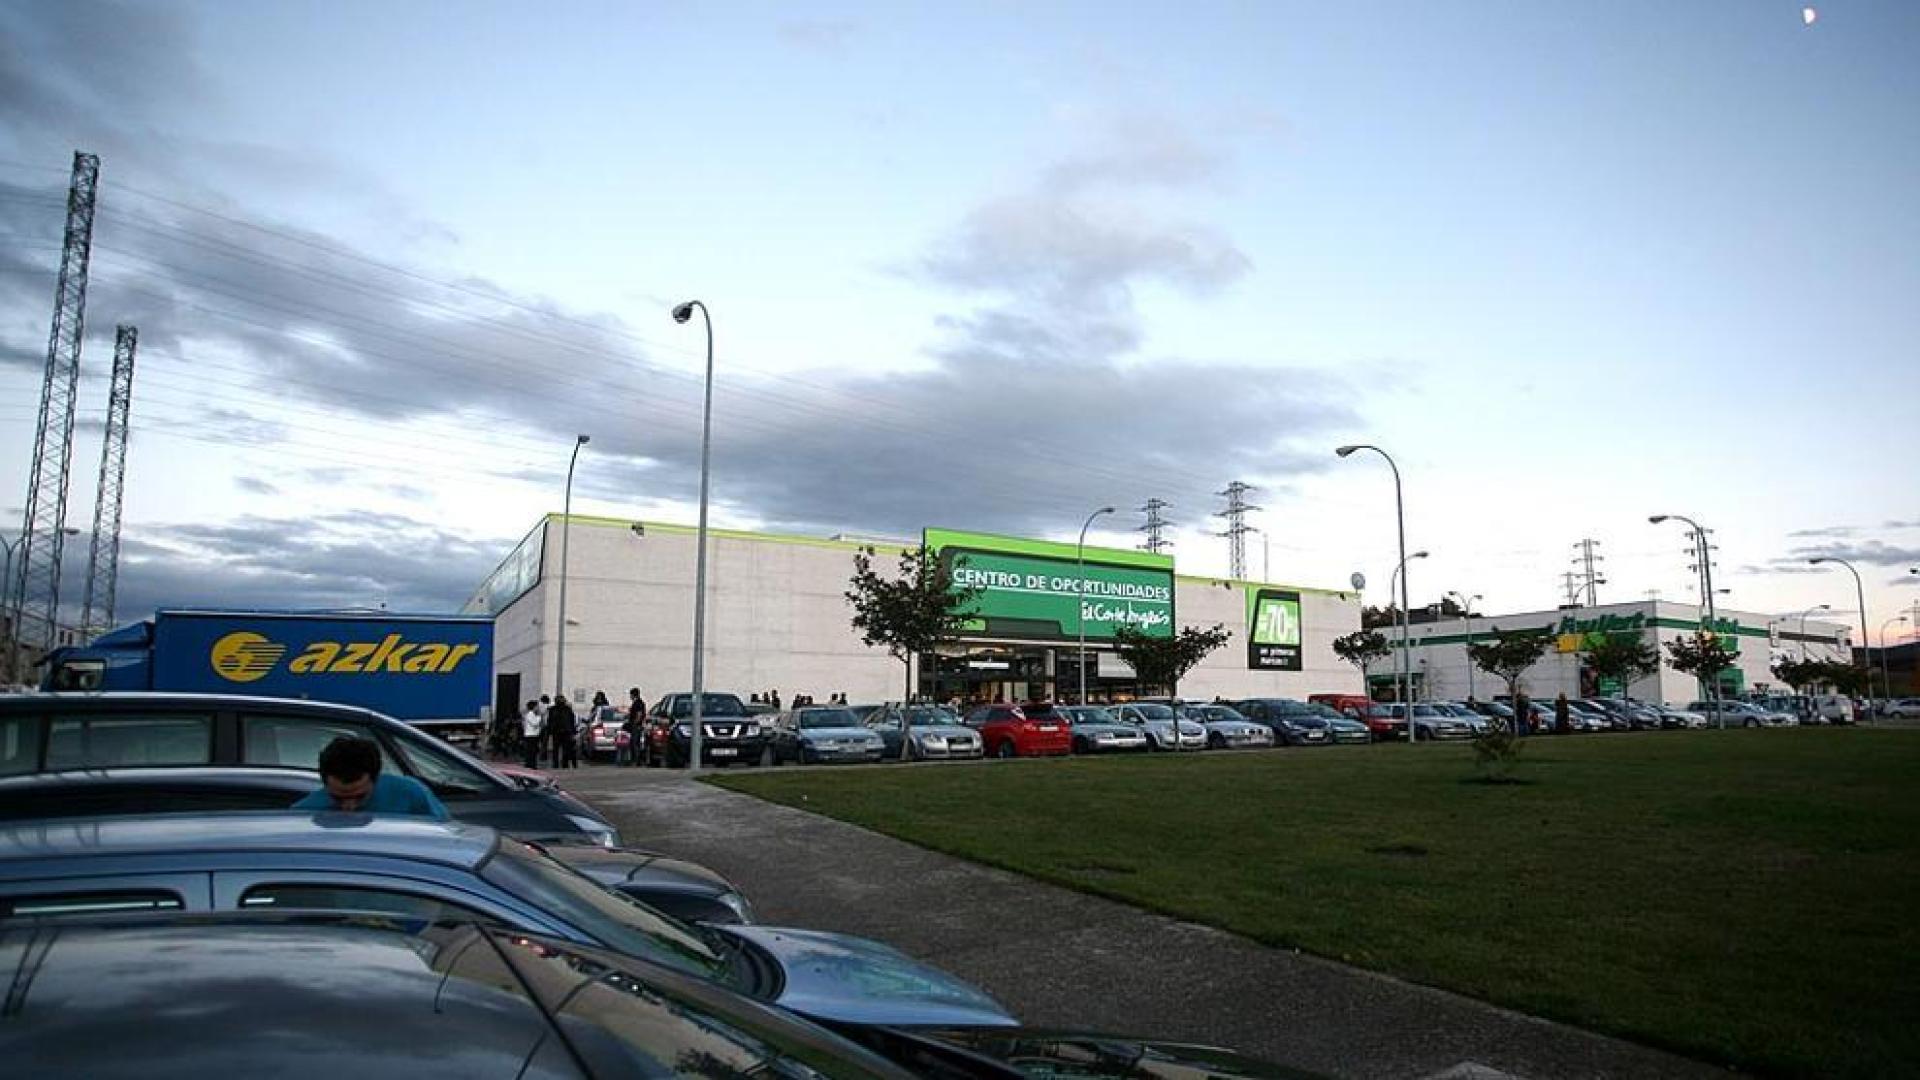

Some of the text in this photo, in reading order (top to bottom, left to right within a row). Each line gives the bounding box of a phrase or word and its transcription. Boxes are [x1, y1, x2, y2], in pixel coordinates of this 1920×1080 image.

[953, 568, 1170, 600] CENTRO DE OPORTUNIDADES
[1081, 601, 1093, 620] El
[1094, 603, 1125, 622] Corte
[289, 633, 480, 672] azkar
